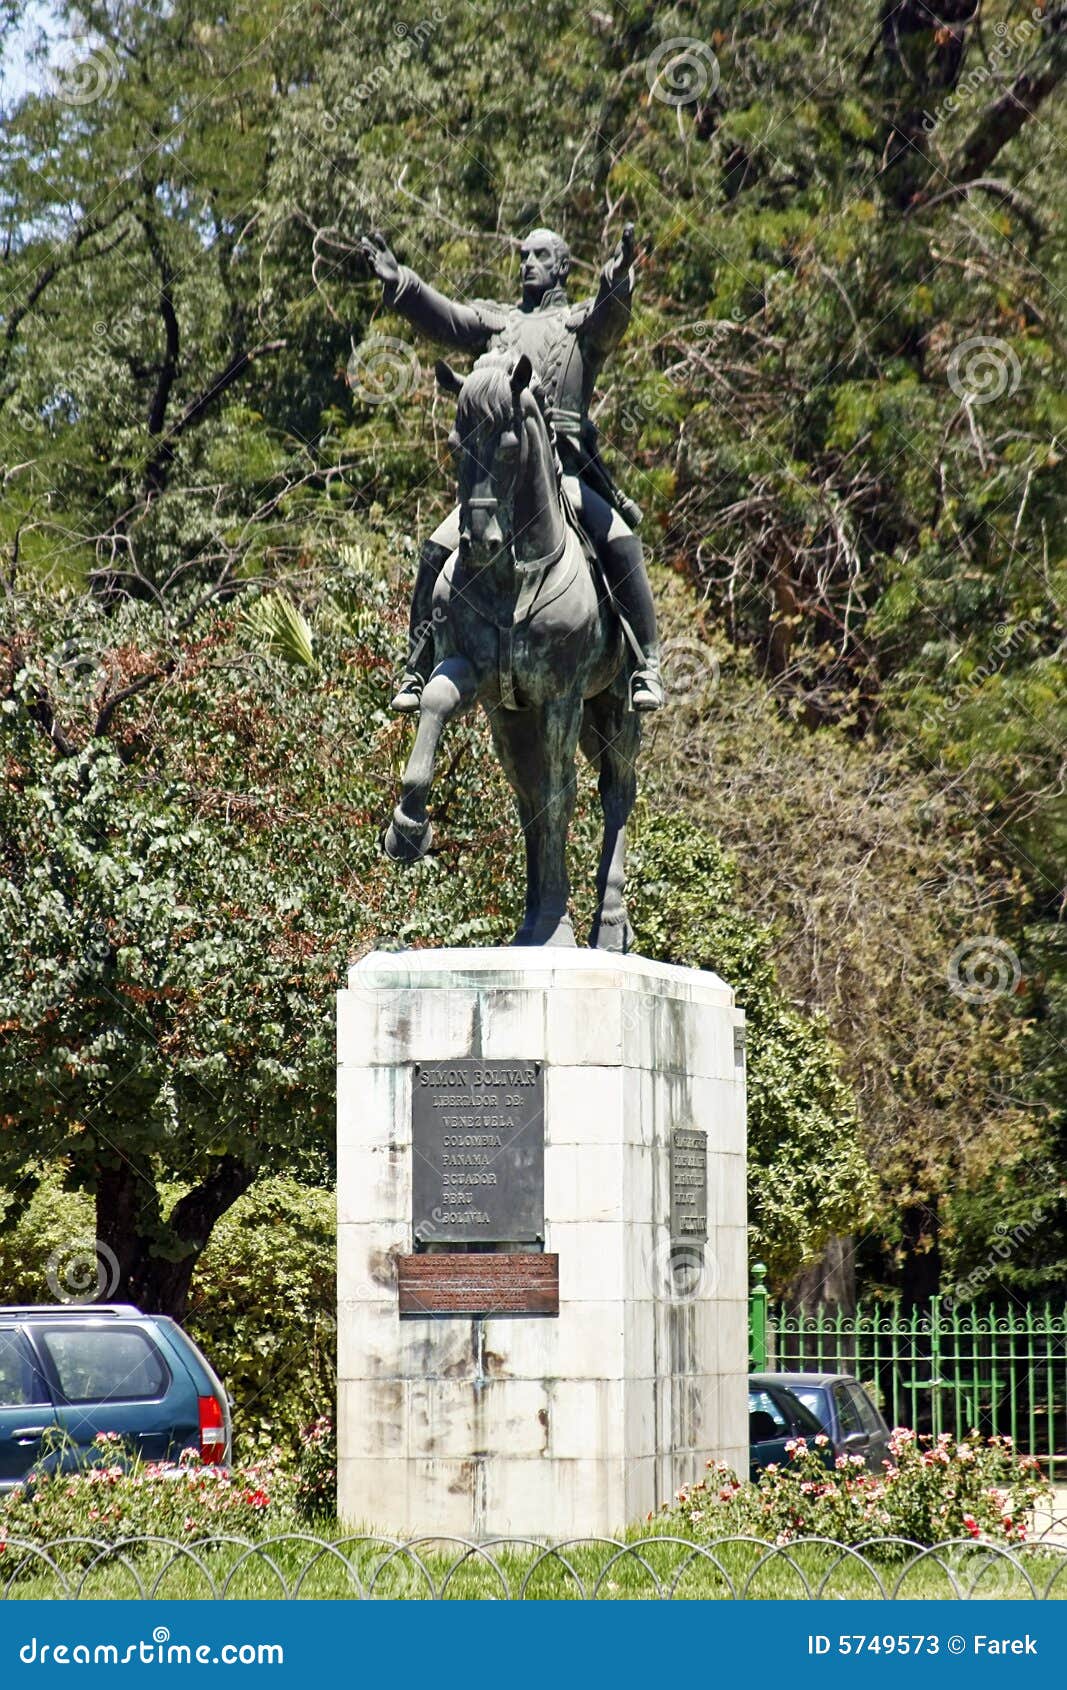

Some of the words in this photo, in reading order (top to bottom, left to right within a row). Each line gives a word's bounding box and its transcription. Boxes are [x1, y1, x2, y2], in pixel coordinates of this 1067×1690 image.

[420, 1069, 468, 1087] SIMON
[473, 1069, 536, 1087] BOLIVAR
[432, 1095, 498, 1108] LIBERTADOR
[442, 1116, 515, 1128] VENEZUELA
[442, 1135, 502, 1147] COLOMBIA
[442, 1154, 490, 1166] PANAMA
[442, 1173, 497, 1185] ECUADOR
[442, 1192, 473, 1205] PERU
[442, 1211, 490, 1224] BOLIVIA
